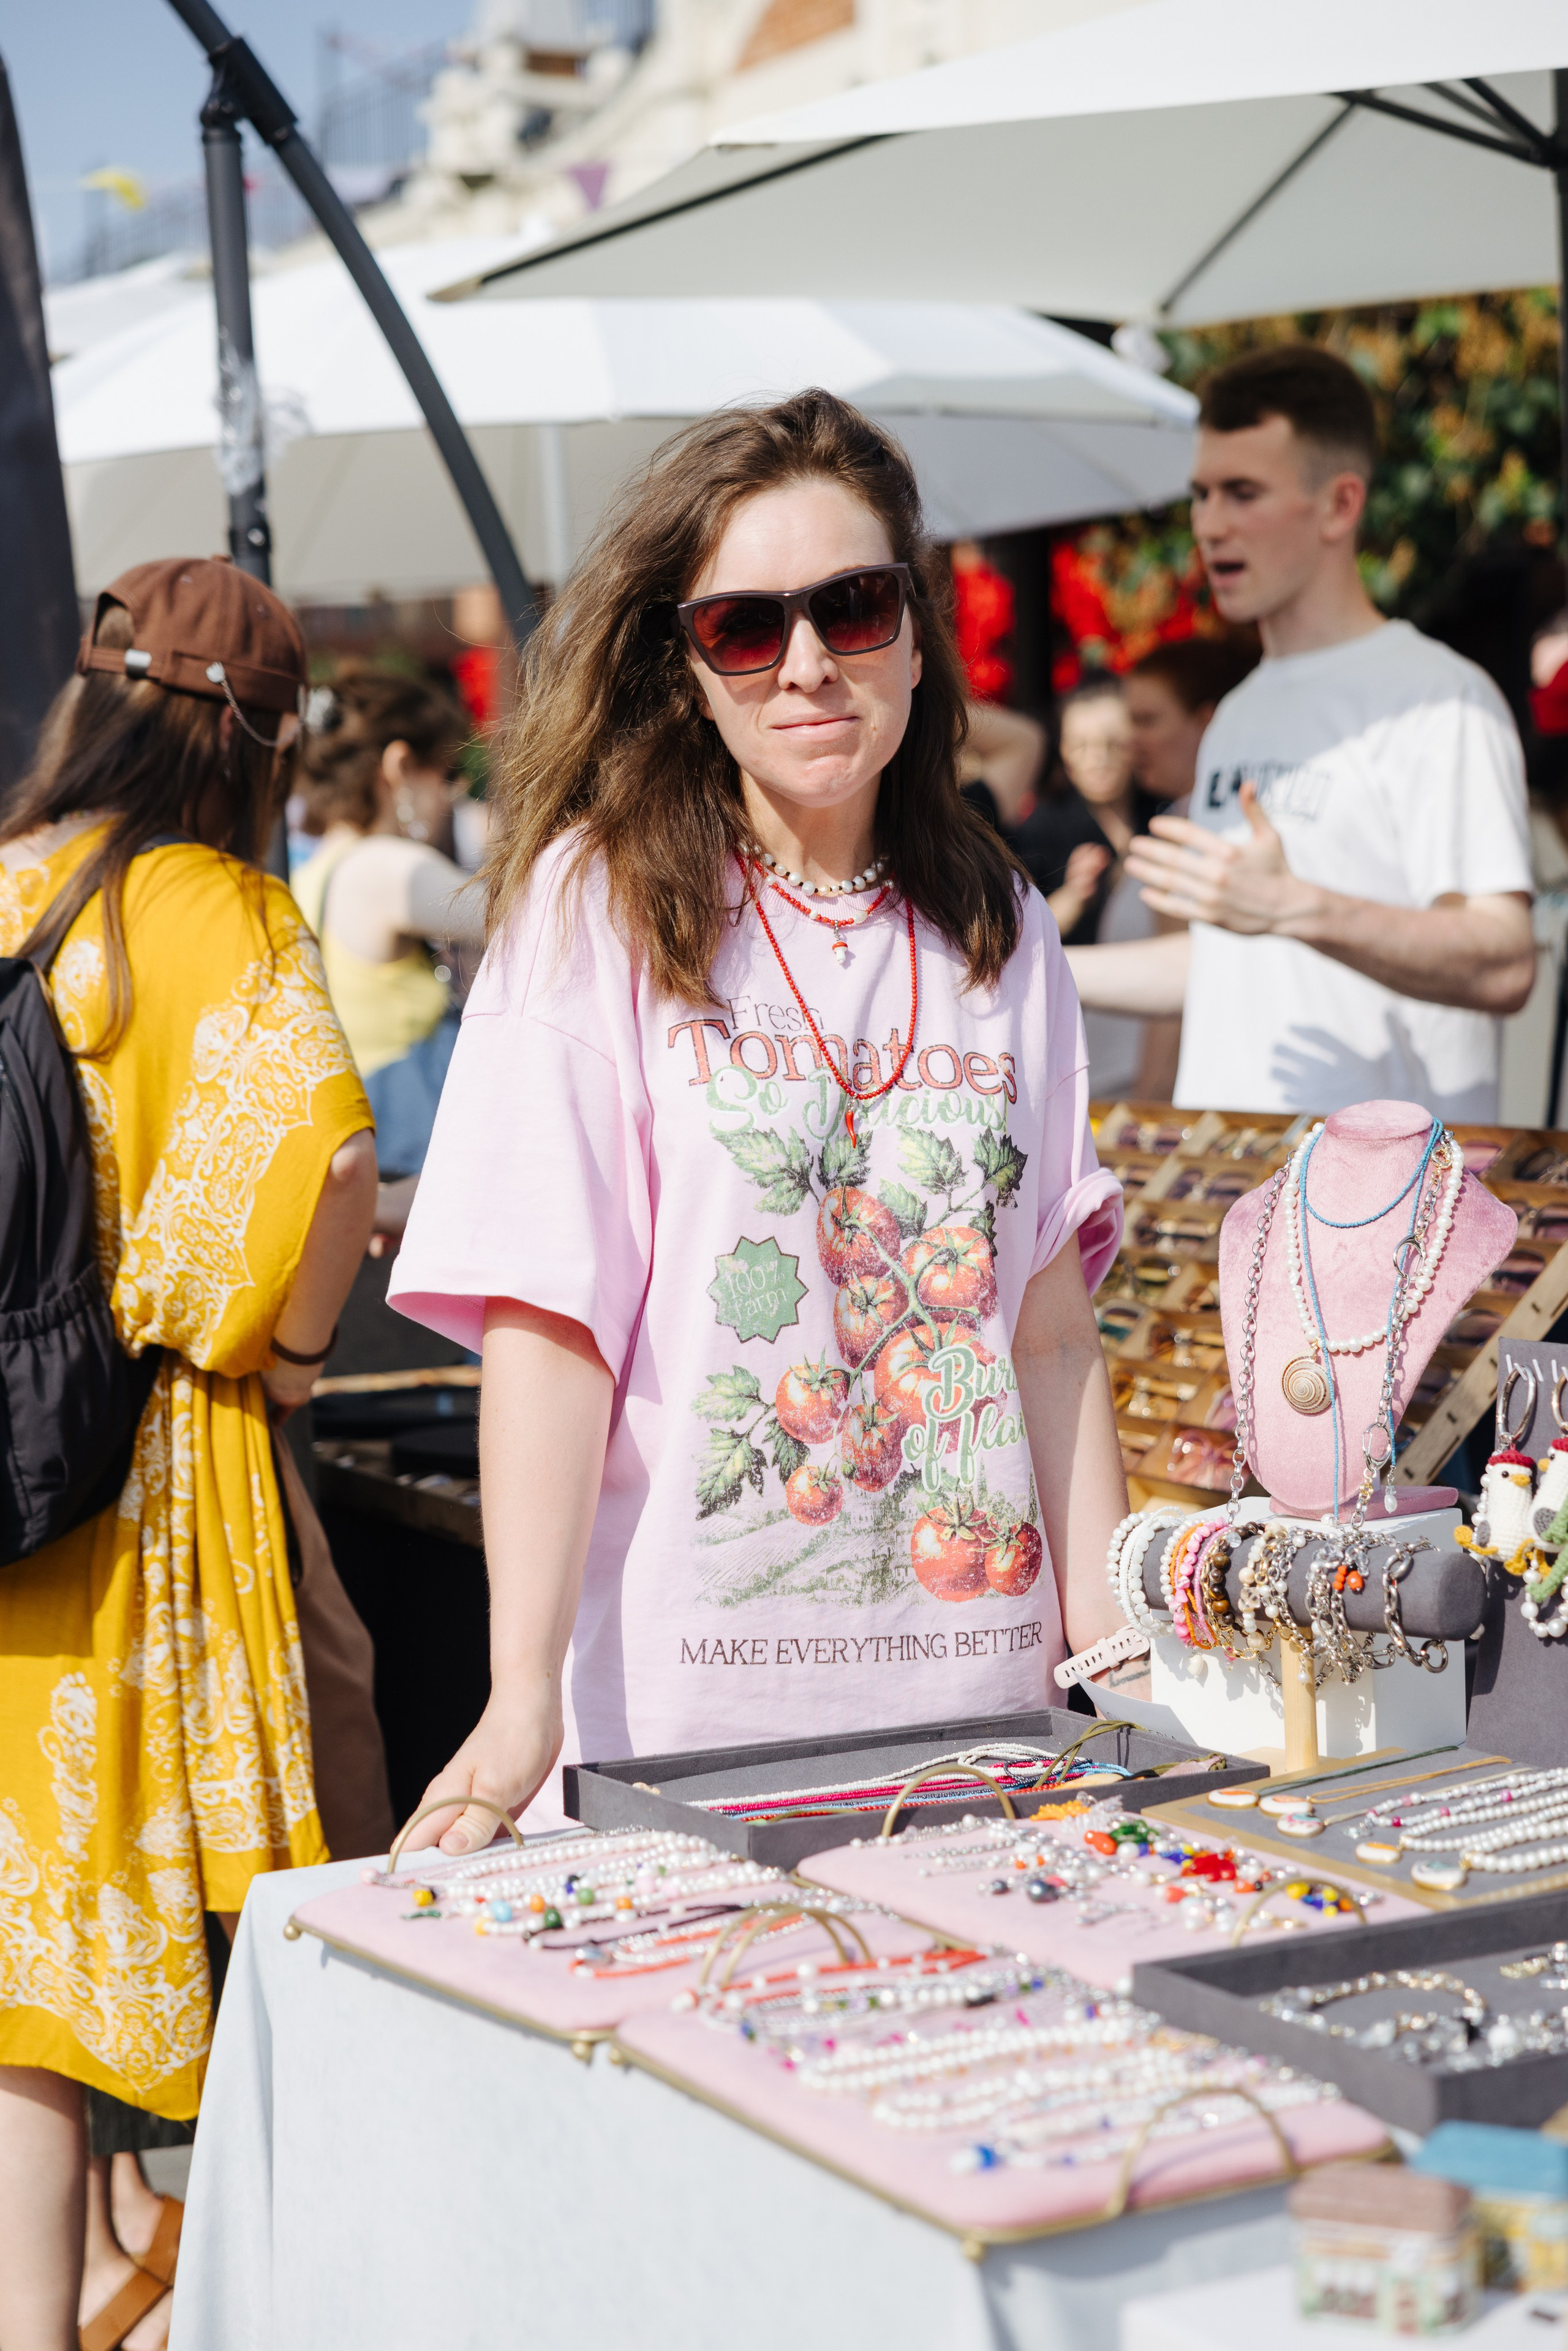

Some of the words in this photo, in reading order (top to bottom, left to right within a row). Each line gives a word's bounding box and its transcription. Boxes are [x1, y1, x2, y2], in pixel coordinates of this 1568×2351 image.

[668, 1019, 1017, 1104] Tomatoes
[706, 1064, 788, 1135] So
[903, 1417, 949, 1492] of
[679, 1637, 768, 1665] MAKE
[775, 1632, 948, 1664] EVERYTHING
[954, 1621, 1042, 1658] BETTER
